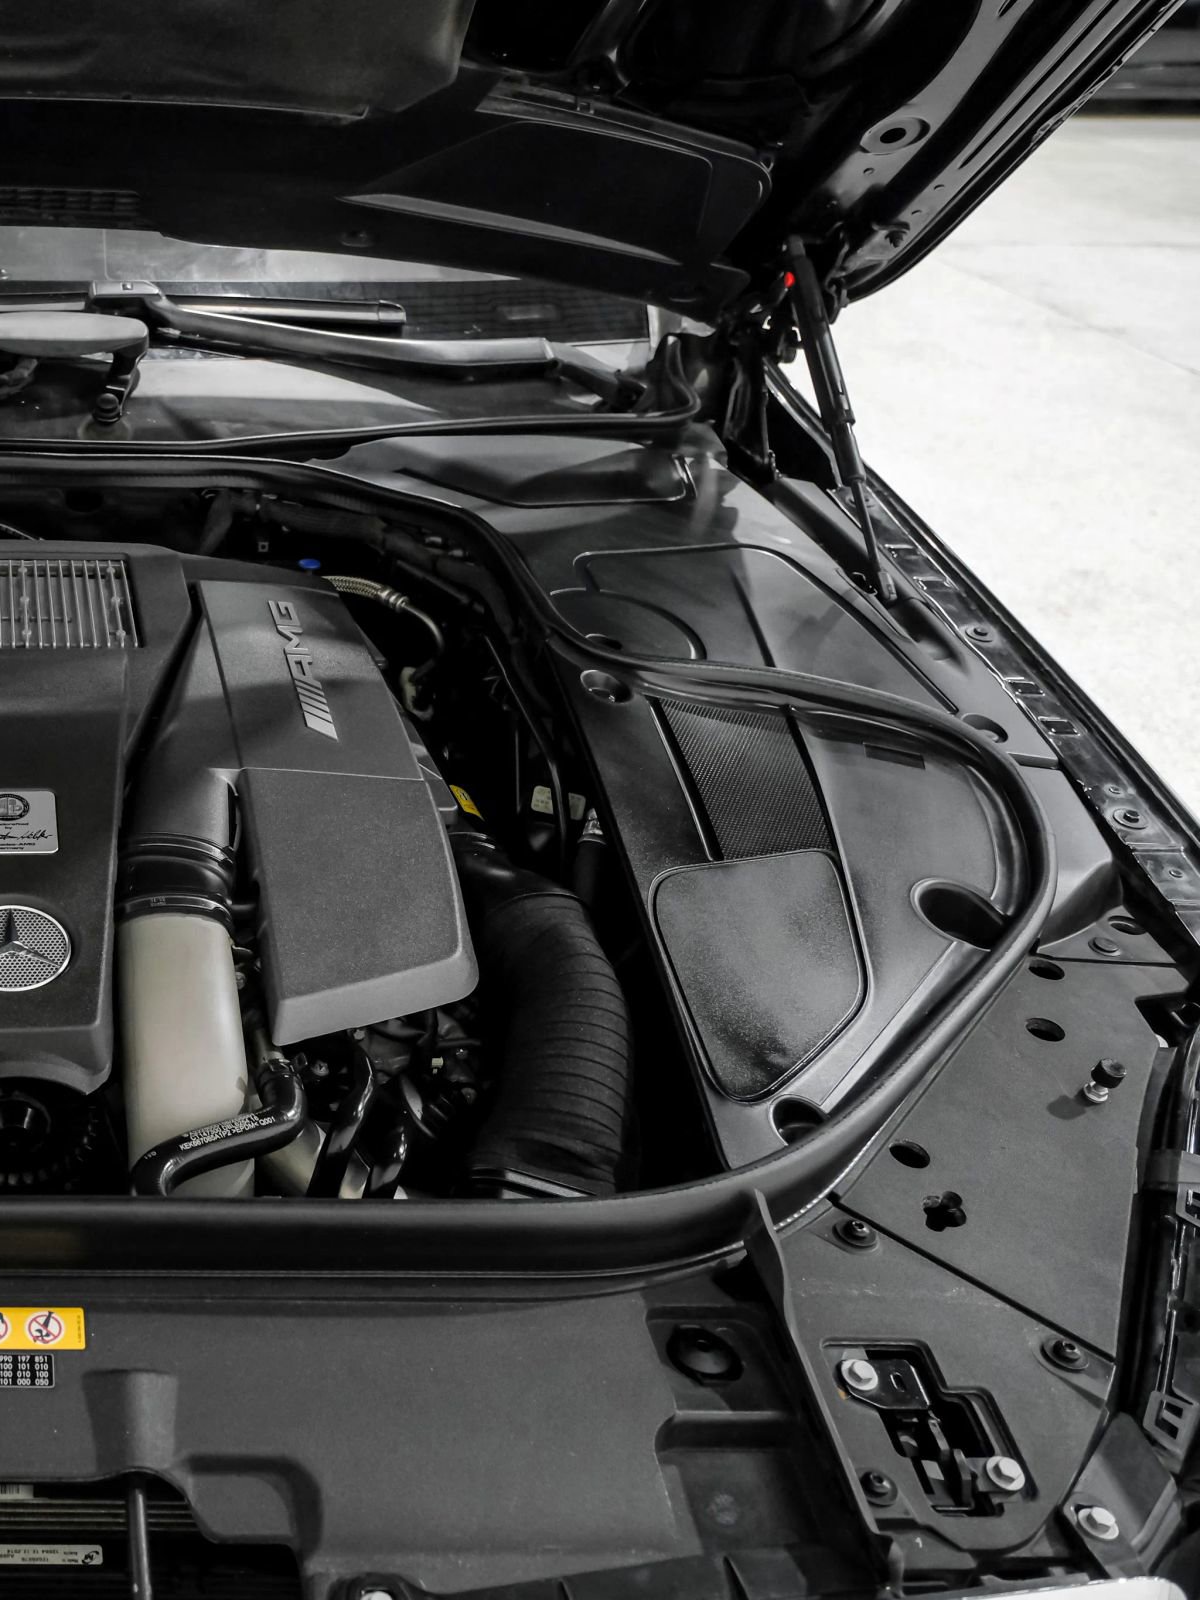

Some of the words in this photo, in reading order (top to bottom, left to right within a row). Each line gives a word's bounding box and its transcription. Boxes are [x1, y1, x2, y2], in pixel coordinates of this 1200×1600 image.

[267, 599, 323, 690] AMG
[0, 1362, 13, 1370] 100
[18, 1362, 30, 1370] 101
[34, 1362, 49, 1370] 010
[0, 1370, 13, 1378] 100
[17, 1370, 31, 1378] 010
[36, 1370, 49, 1378] 100
